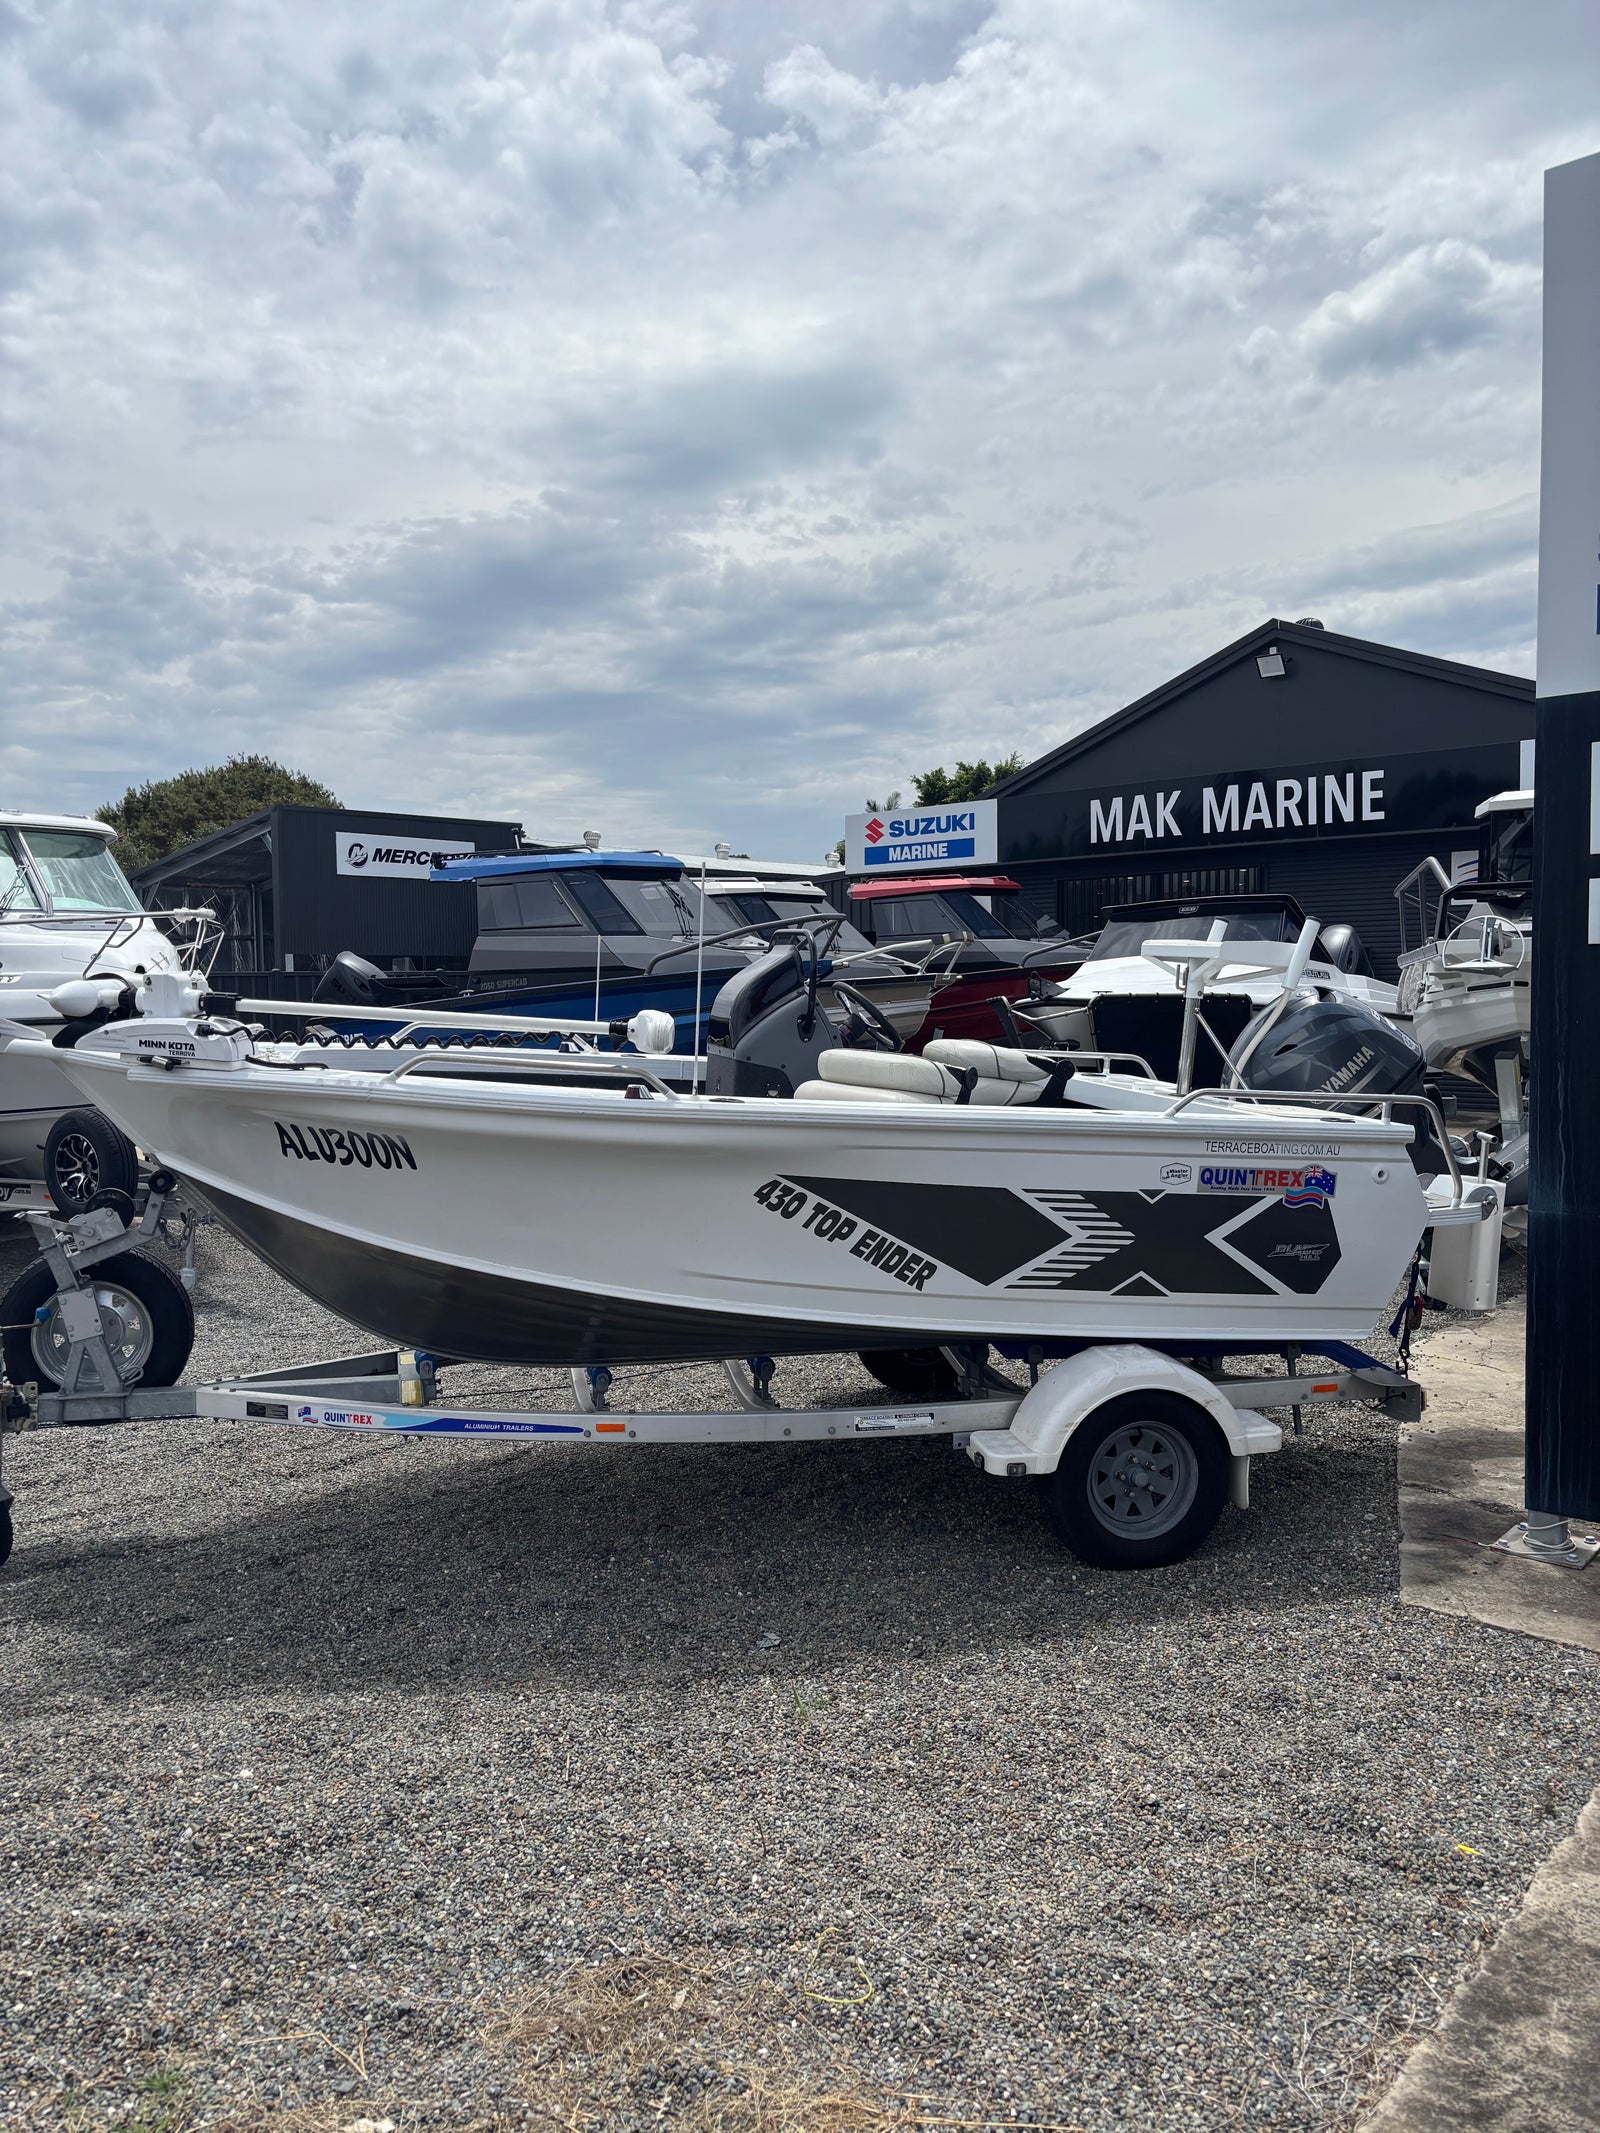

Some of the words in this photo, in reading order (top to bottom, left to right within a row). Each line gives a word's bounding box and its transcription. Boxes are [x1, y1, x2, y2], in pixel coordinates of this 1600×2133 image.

[1089, 789, 1183, 844] MAK
[1202, 769, 1386, 835] MARINE
[888, 812, 975, 838] SUZUKI
[888, 842, 949, 862] MARINE
[496, 977, 528, 990] SUPERCAB
[138, 1039, 166, 1049] MINN
[168, 1041, 196, 1052] KOTA
[1321, 1045, 1375, 1093] YAMAHA
[273, 1121, 418, 1171] ALU300N
[1204, 1140, 1341, 1156] TERRACEBOATING.COM.AU
[1200, 1167, 1303, 1187] QUINTREX
[753, 1179, 808, 1220] 430
[802, 1201, 858, 1243] TOP
[848, 1228, 938, 1292] ENDER
[324, 1411, 373, 1425] QUINTREX
[502, 1424, 534, 1432] TRAILERS
